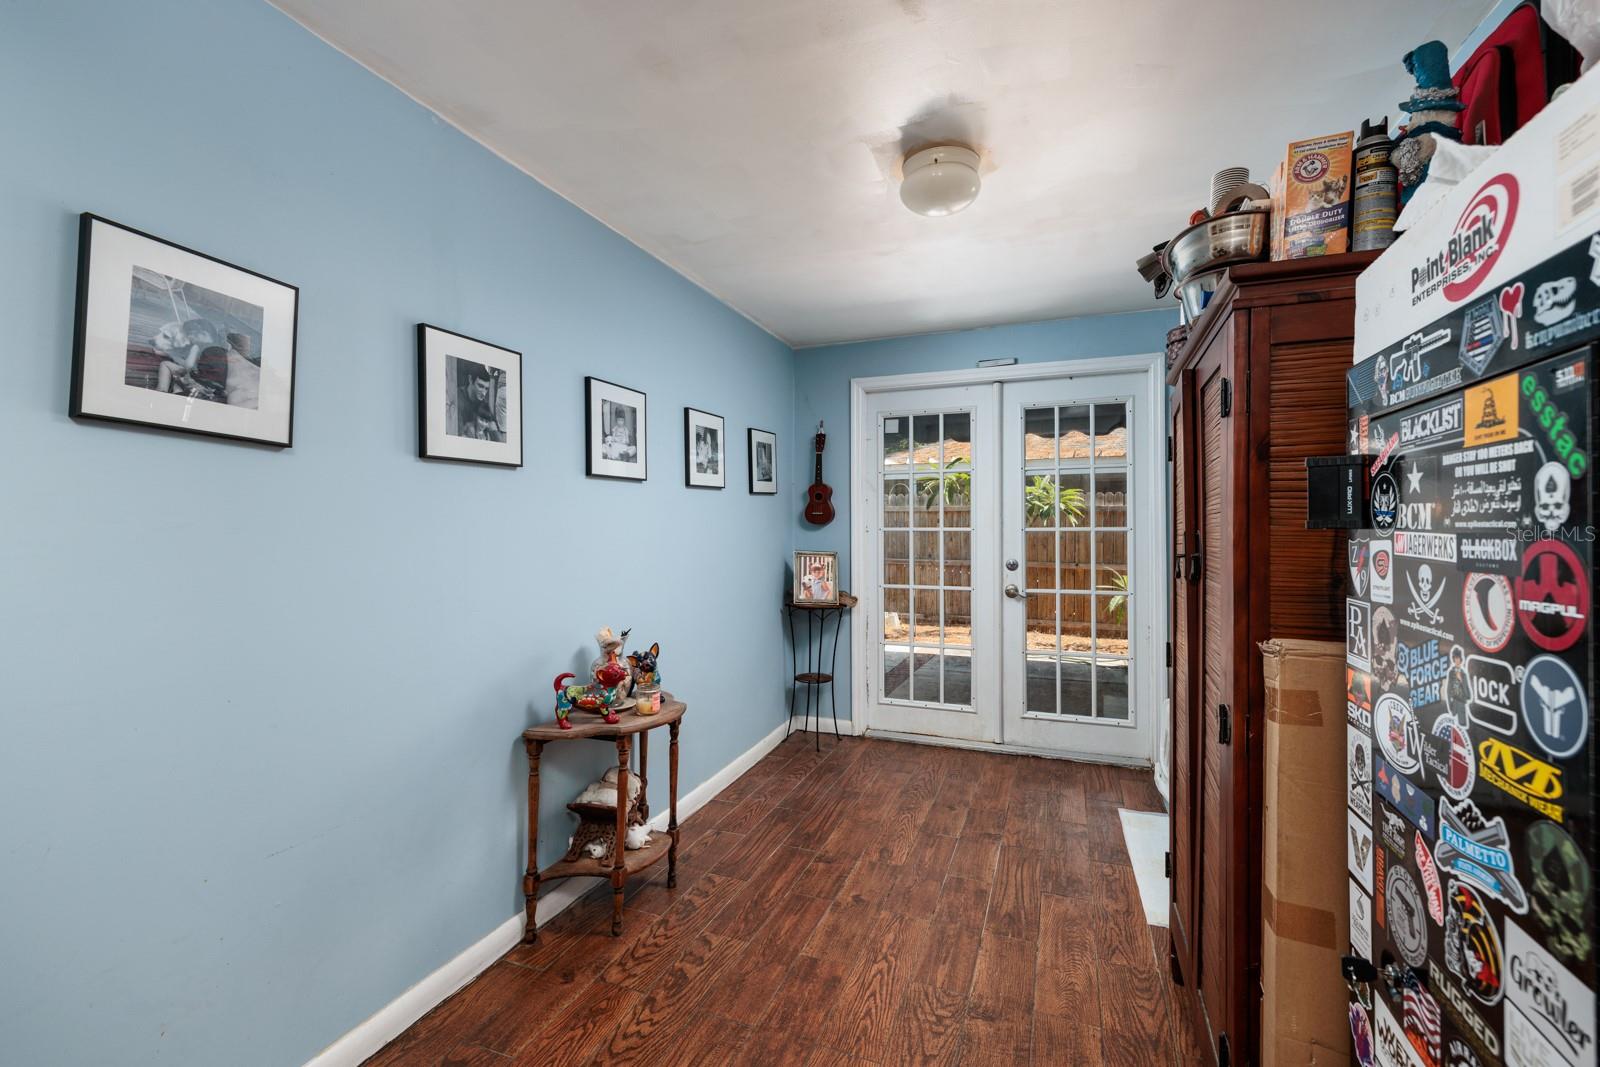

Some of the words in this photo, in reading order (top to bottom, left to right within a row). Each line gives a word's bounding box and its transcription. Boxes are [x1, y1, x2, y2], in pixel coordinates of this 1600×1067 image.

[1290, 213, 1319, 226] DOUBLE
[1322, 207, 1343, 218] DUTY
[1411, 252, 1445, 293] Point
[1448, 214, 1494, 267] Blank
[1401, 402, 1461, 443] BLACKLIST
[1521, 374, 1587, 478] esstac
[1396, 502, 1432, 530] BCM
[1461, 538, 1518, 562] BLACKBOX
[1519, 599, 1585, 619] MAGPUL
[1410, 639, 1439, 668] BLUE
[1410, 655, 1448, 688] FORCE
[1410, 681, 1440, 709] GEAR
[1347, 702, 1371, 729] SKD
[1445, 828, 1506, 868] PALMETTO
[1429, 959, 1500, 1056] RUGGED
